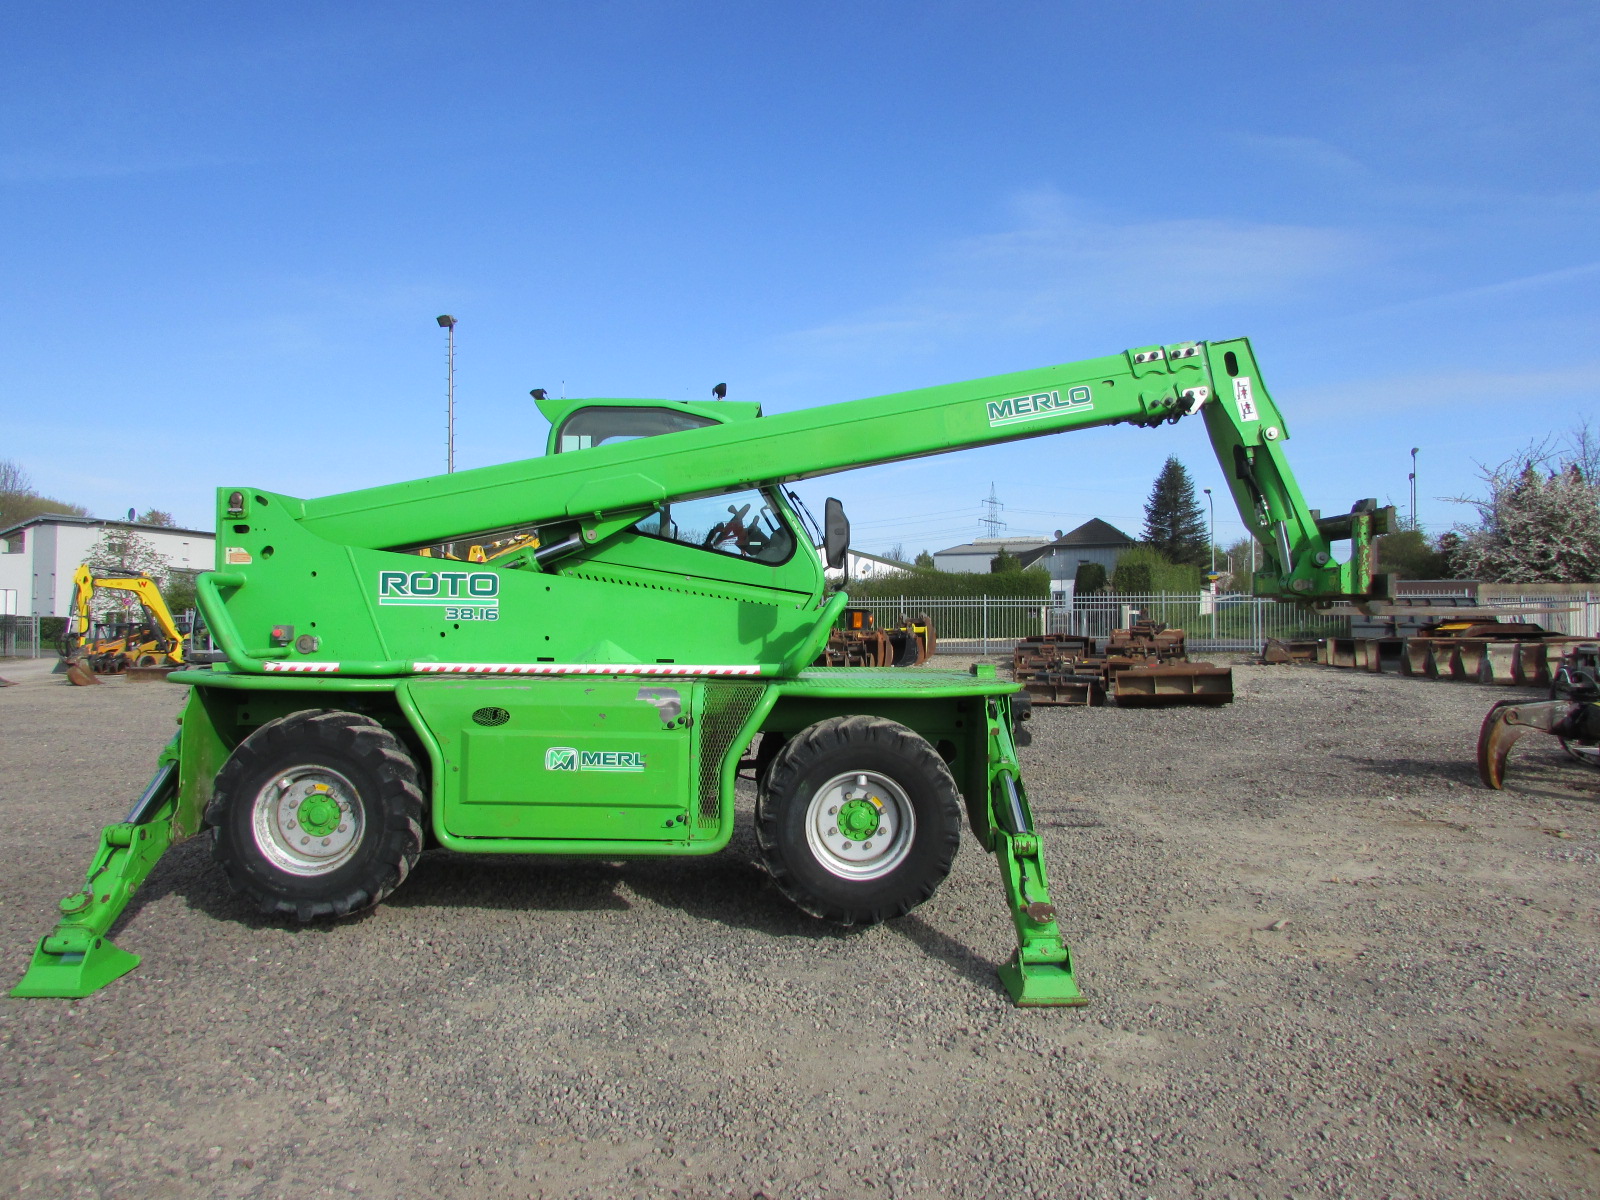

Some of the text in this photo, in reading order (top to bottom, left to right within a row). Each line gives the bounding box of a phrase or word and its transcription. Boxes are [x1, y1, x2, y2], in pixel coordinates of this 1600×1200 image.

[986, 385, 1092, 420] MERLO
[380, 571, 499, 597] ROTO
[445, 607, 499, 621] 38.16
